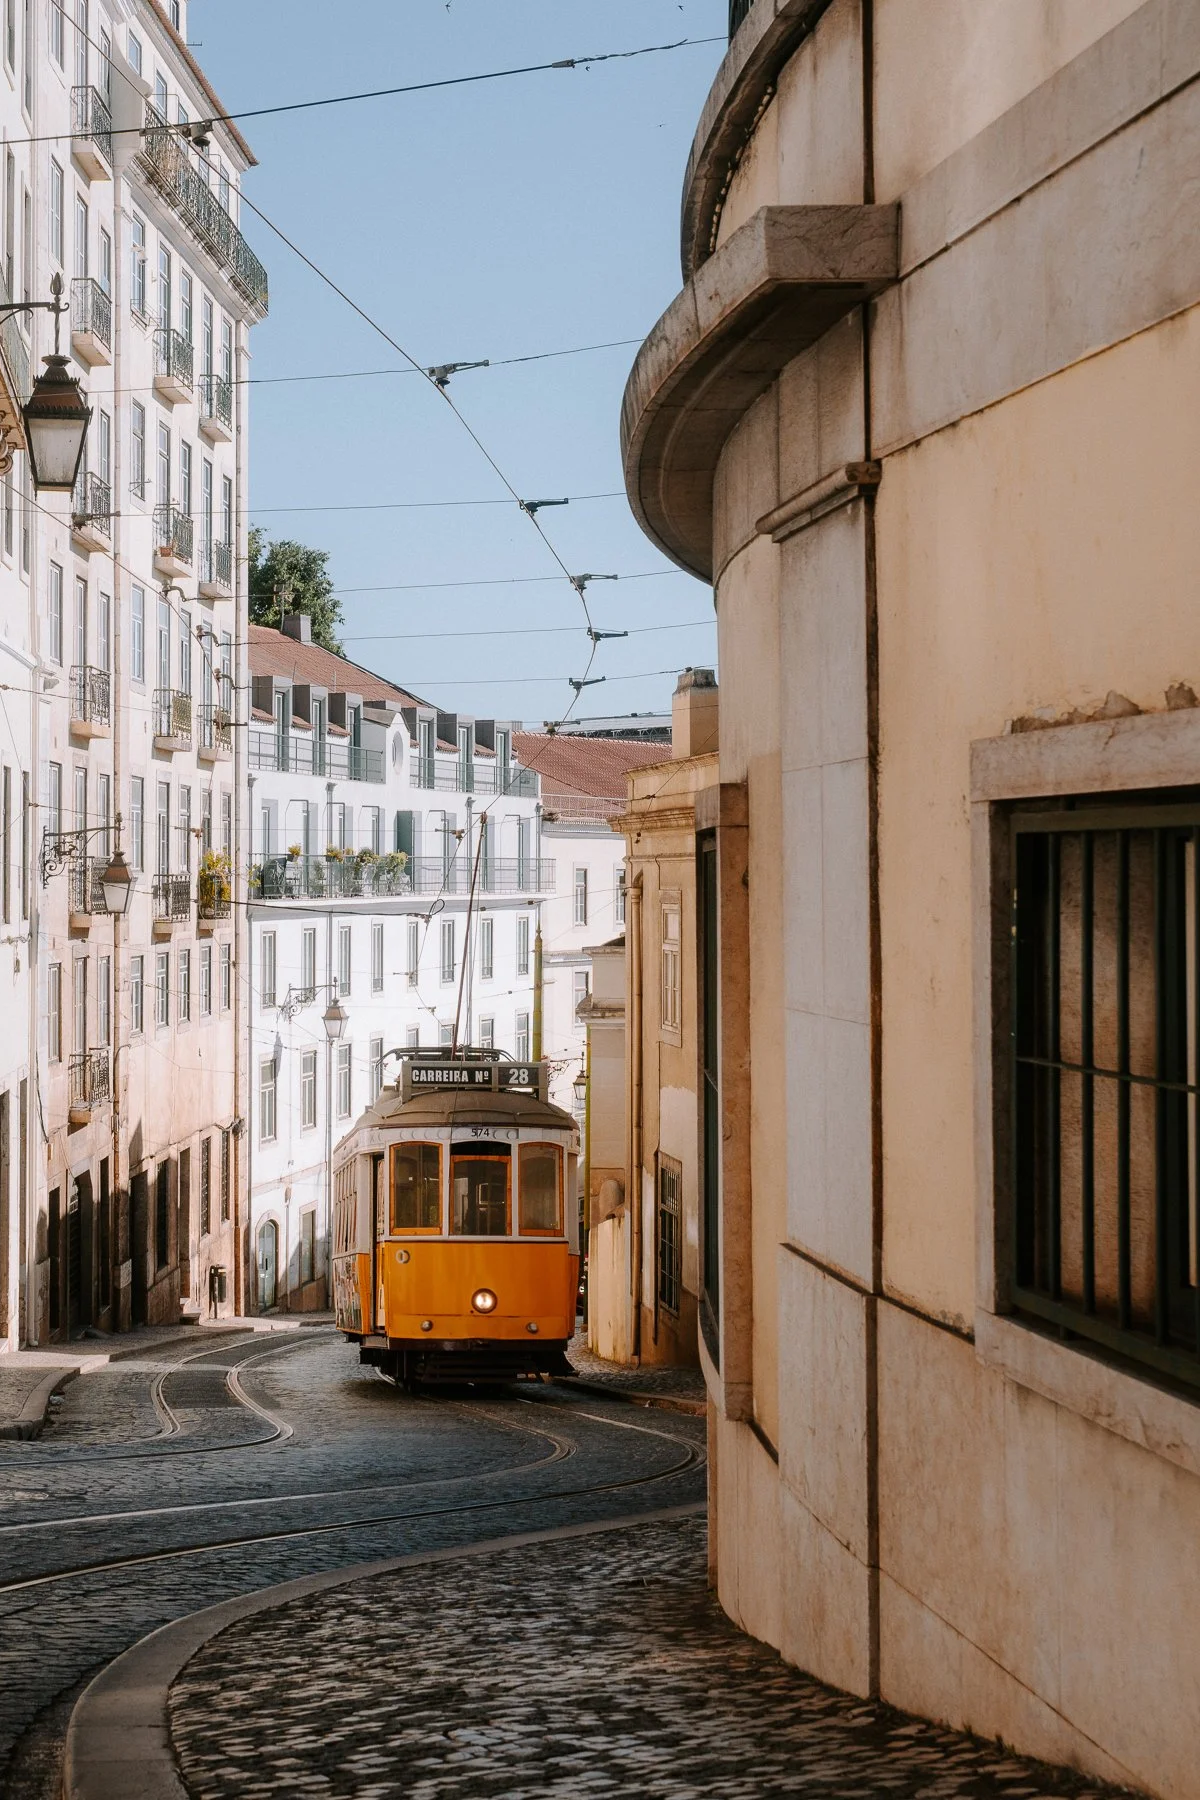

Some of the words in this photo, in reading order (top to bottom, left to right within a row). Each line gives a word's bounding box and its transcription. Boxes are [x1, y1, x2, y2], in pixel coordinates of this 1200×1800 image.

[412, 1069, 469, 1082] CARREIRA
[508, 1068, 529, 1085] 28
[471, 1128, 490, 1137] 574
